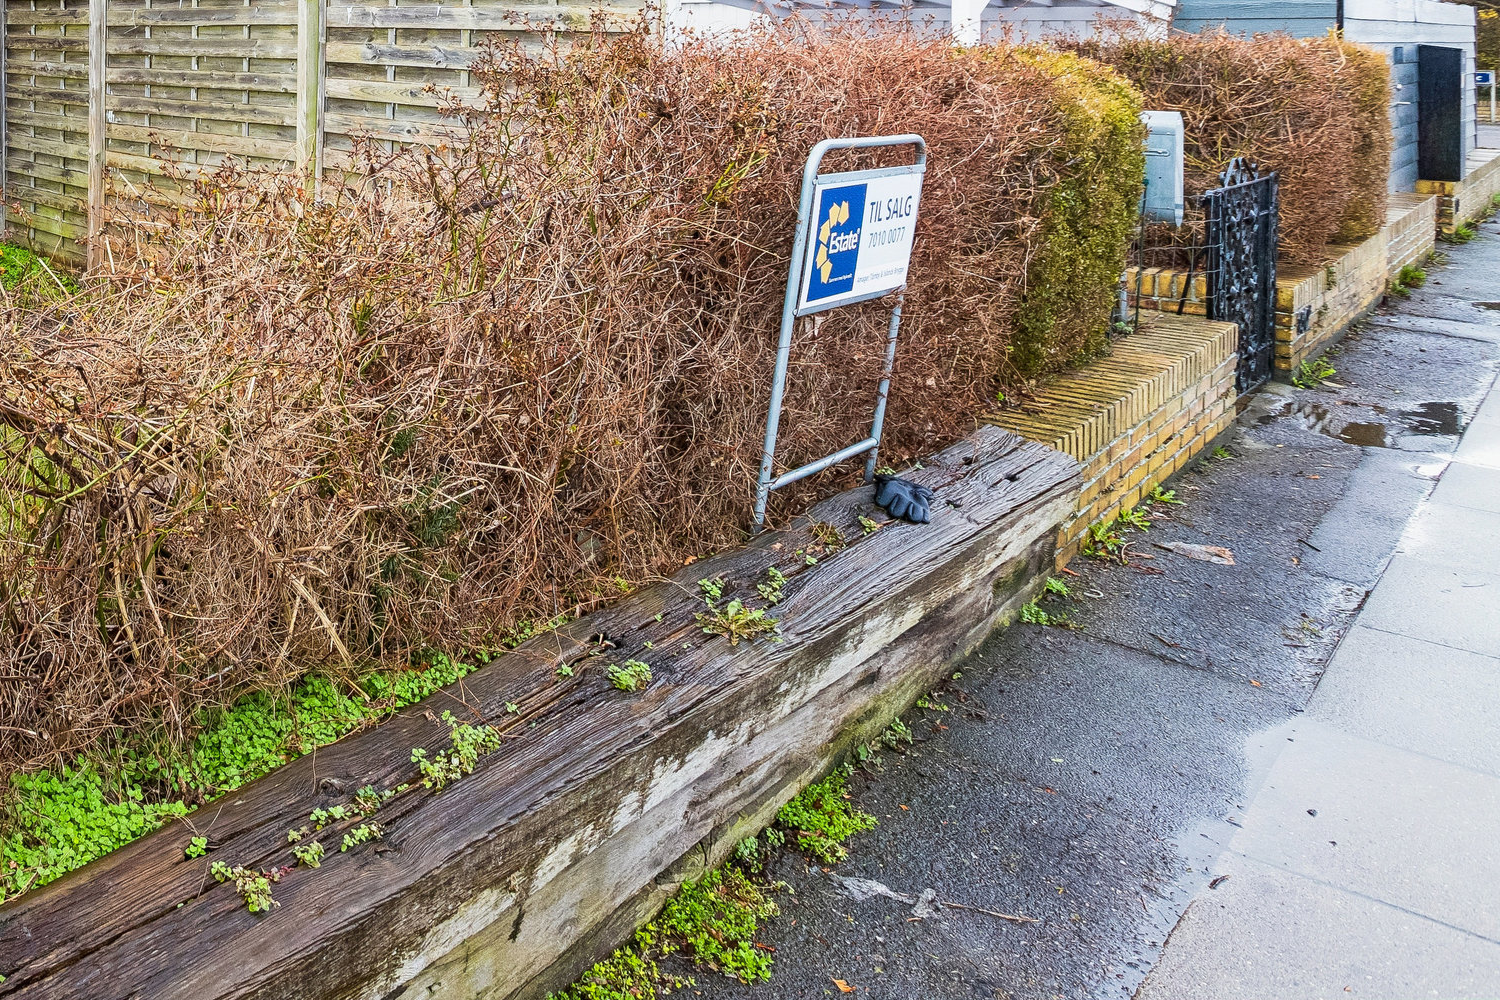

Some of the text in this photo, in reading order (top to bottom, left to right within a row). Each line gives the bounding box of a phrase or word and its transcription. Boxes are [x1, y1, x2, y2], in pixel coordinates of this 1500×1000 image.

[870, 196, 912, 223] TIL SALG
[829, 230, 859, 254] Estate
[868, 227, 905, 248] 7010 0077
